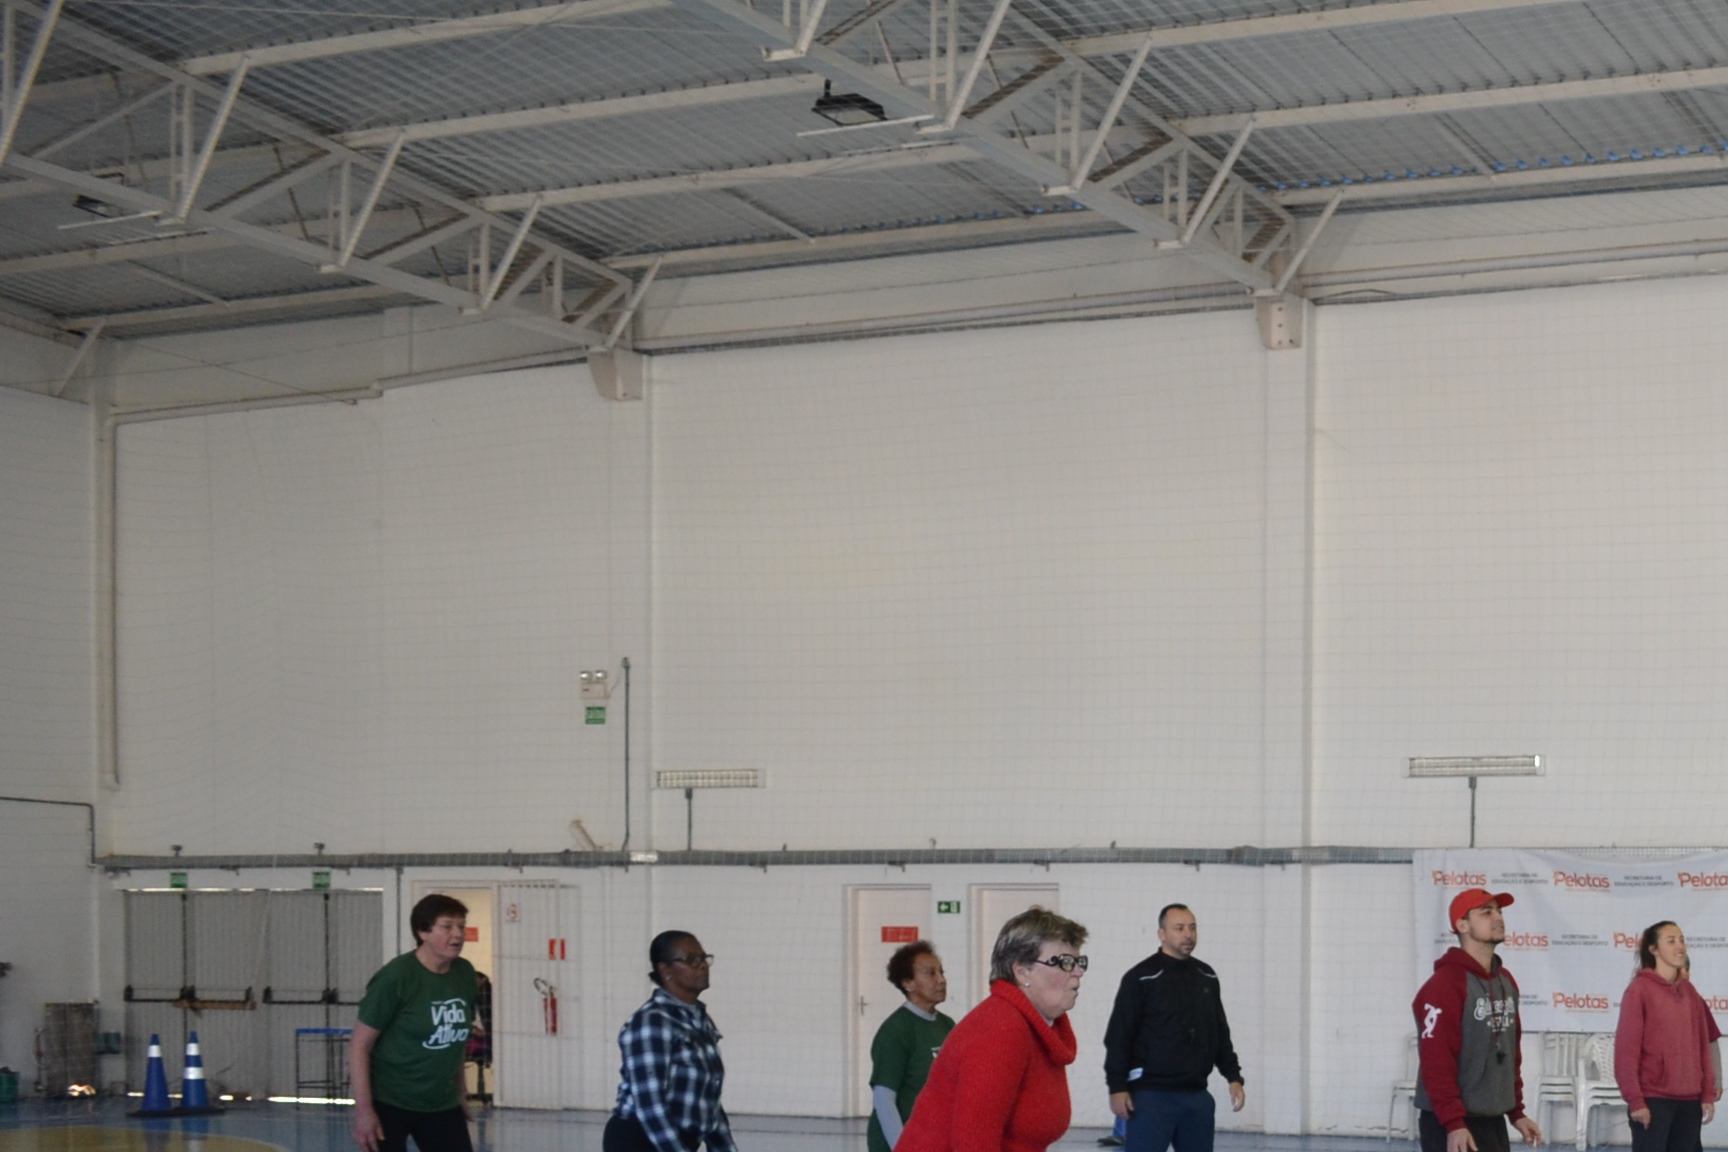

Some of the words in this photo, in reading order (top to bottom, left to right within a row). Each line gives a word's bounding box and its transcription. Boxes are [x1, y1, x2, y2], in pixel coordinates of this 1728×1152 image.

[1432, 870, 1487, 886] Pelotas
[1553, 871, 1610, 888] Pelotas
[1503, 931, 1549, 947] elotas
[1552, 992, 1609, 1009] Pelotas
[431, 1003, 466, 1026] Vida
[428, 1024, 469, 1044] Ativa
